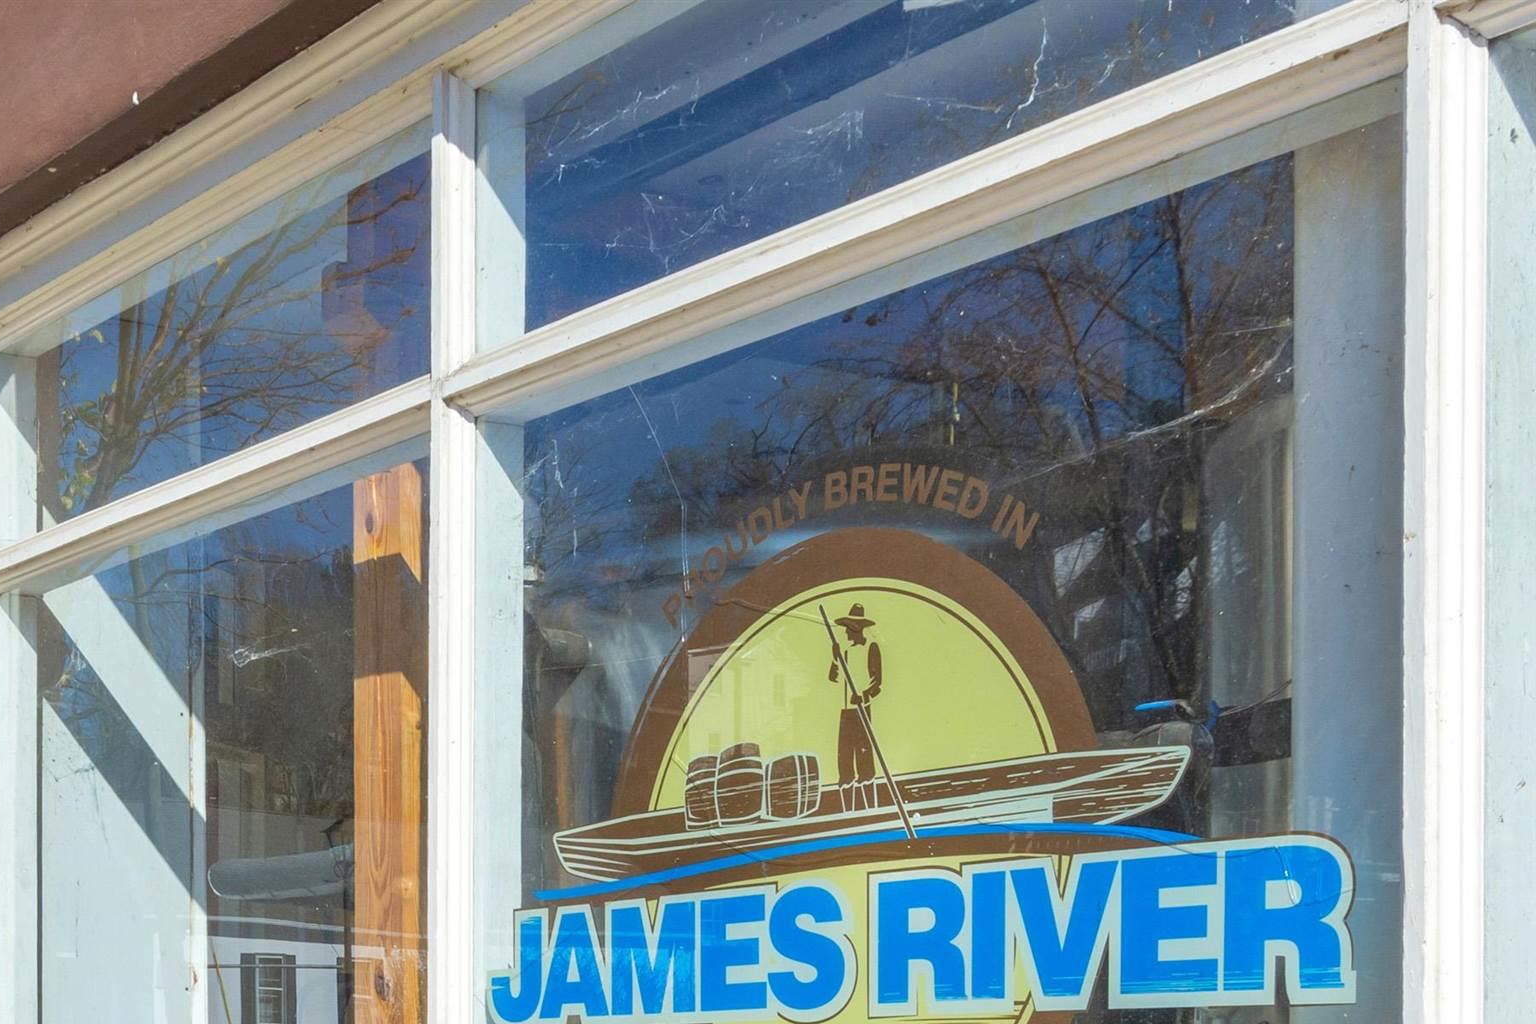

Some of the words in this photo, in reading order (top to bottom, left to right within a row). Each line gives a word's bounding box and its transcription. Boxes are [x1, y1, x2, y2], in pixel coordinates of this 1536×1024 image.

[824, 462, 991, 520] BREWED
[990, 494, 1042, 551] IN
[488, 882, 847, 1024] JAMES
[876, 843, 1348, 1006] RIVER
